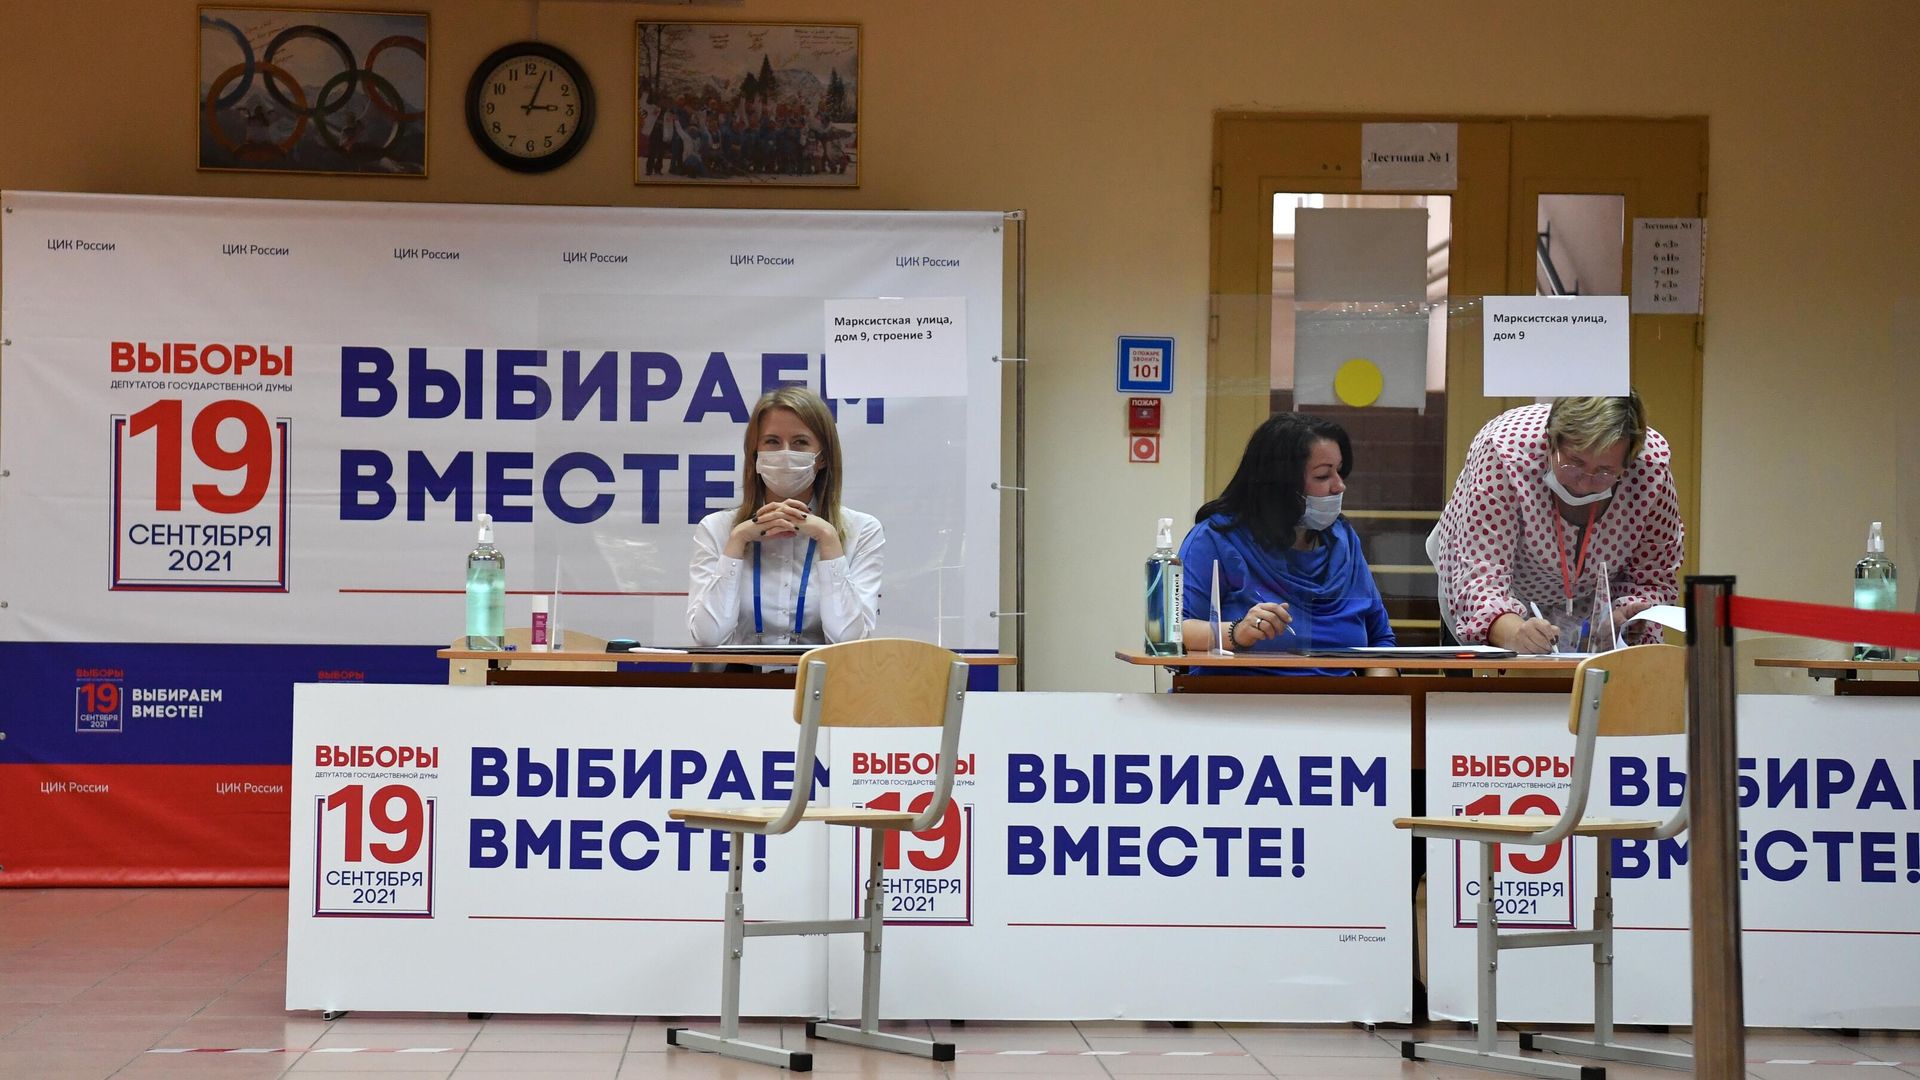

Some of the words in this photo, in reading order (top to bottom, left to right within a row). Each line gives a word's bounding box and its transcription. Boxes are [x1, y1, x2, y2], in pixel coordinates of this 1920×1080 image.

[509, 69, 518, 81] 11
[525, 63, 537, 75] 12
[549, 70, 553, 82] 1
[494, 83, 506, 95] 10
[561, 84, 569, 96] 2
[486, 102, 495, 115] 9
[566, 104, 574, 116] 3
[492, 121, 501, 133] 8
[557, 123, 567, 135] 4
[508, 135, 517, 147] 7
[526, 140, 535, 152] 6
[544, 136, 553, 148] 5
[1445, 152, 1449, 163] 1
[47, 238, 73, 251] ЦИК
[75, 239, 116, 251] России
[222, 243, 248, 257] ЦИК
[250, 244, 290, 256] России
[393, 248, 419, 261] ЦИК
[421, 248, 460, 260] России
[562, 251, 588, 264] ЦИК
[589, 252, 628, 263] России
[730, 254, 754, 267] ЦИК
[756, 254, 795, 266] России
[895, 256, 920, 268] ЦИК
[922, 256, 960, 267] России
[834, 316, 911, 328] Марксистская
[916, 316, 953, 327] улица,
[1493, 313, 1569, 325] Марксистская
[1571, 315, 1607, 325] улица,
[834, 334, 858, 344] дом
[860, 331, 870, 343] 9,
[872, 332, 924, 343] строение
[926, 330, 933, 340] 3
[1492, 332, 1516, 342] дом
[1518, 330, 1525, 340] 9
[110, 341, 293, 377] ВЫБОРЫ
[1132, 364, 1160, 378] 101
[110, 380, 166, 390] ДЕПУТАТОВ
[167, 381, 263, 392] ГОСУДАРСТВЕННОЙ
[264, 383, 293, 393] ДУМЫ
[340, 346, 884, 425] ВЫБИРАЕ
[128, 399, 273, 515] 19
[128, 523, 272, 547] СЕНТЯБРЯ
[168, 549, 232, 572] 2021
[76, 668, 124, 678] ВЫБОРЫ
[79, 683, 120, 713] 19
[132, 688, 223, 703] ВЫБИРАЕМ
[80, 713, 118, 722] СЕНТЯБРЯ
[131, 704, 204, 719] ВМЕСТЕ!
[90, 721, 108, 729] 2021
[315, 745, 439, 769] ВЫБОРЫ
[852, 752, 975, 774] ВЫБОЫ
[314, 771, 353, 779] ДЕПУТАТОВ
[353, 771, 419, 779] ГОСУДАРСТВЕННОЙ
[419, 772, 439, 780] ДУМЫ
[1007, 753, 1387, 807] ВЫБИРАЕМ
[40, 781, 67, 794] ЦИК
[69, 782, 109, 793] России
[215, 781, 243, 795] ЦИК
[244, 783, 284, 794] России
[851, 778, 890, 786] ДЕПУТАТОВ
[956, 779, 976, 787] ДУМЫ
[1490, 781, 1557, 789] ГОСУДАРСТВЕННОЙ
[327, 784, 424, 865] 19
[866, 792, 961, 871] 19
[1007, 825, 1306, 879] ВМЕСТЕ!
[326, 870, 423, 887] СЕНТЯБРЯ
[1466, 881, 1564, 896] СНТЯБРЯ
[352, 888, 396, 904] 2021
[891, 895, 934, 912] 2021
[1495, 899, 1536, 914] 2021
[1338, 934, 1357, 943] ЦИК
[1358, 934, 1386, 943] России
